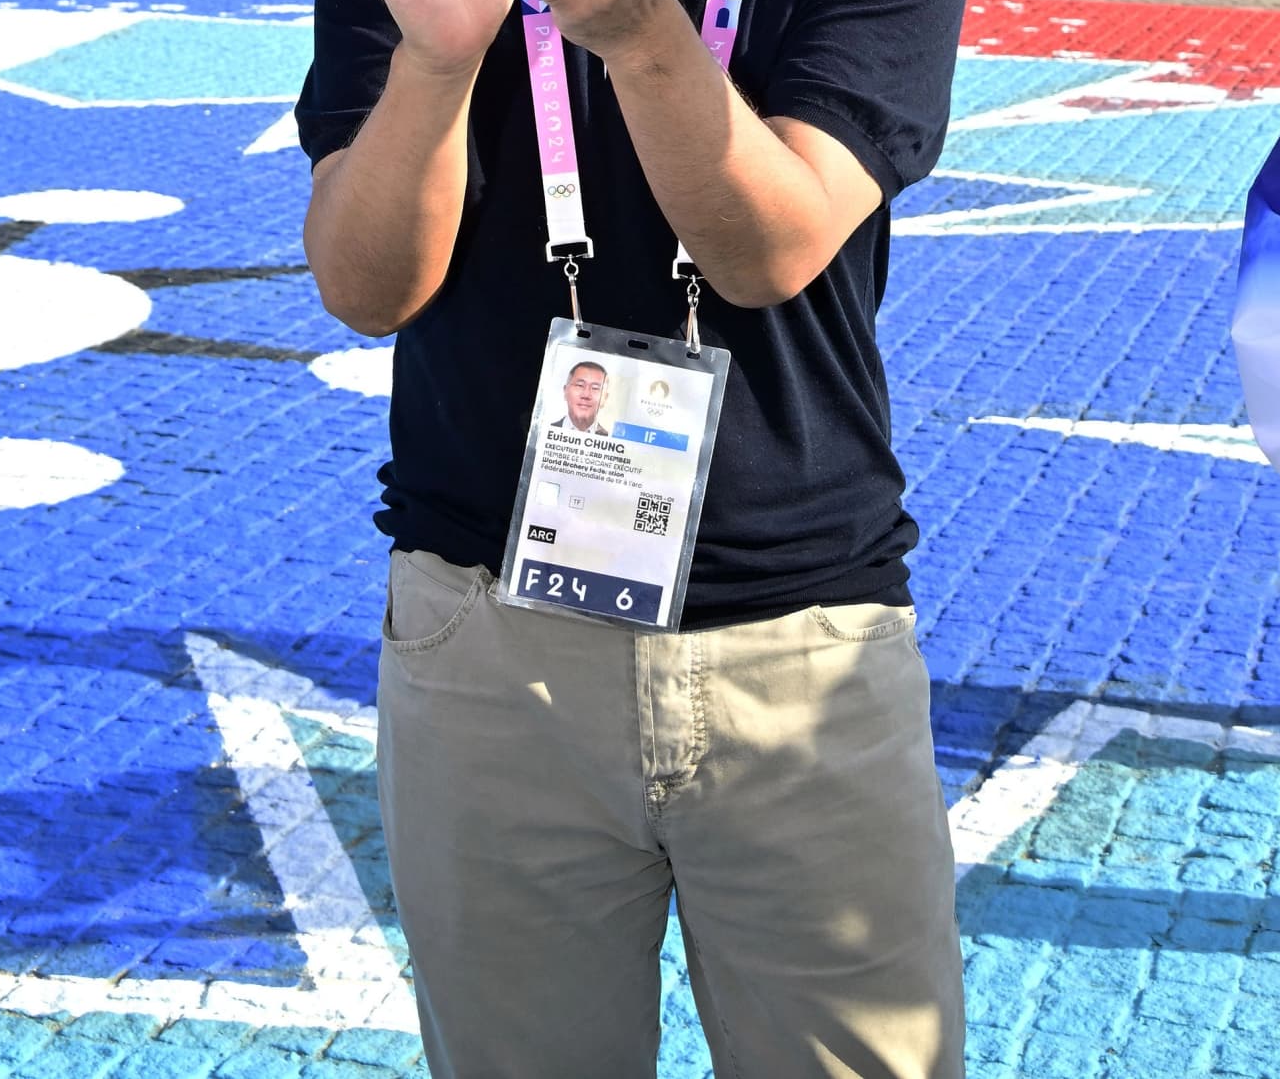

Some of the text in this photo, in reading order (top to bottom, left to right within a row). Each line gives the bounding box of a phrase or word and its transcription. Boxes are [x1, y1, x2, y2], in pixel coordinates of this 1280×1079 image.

[535, 25, 565, 163] PARIS 2024
[547, 430, 625, 454] Euisun CHUNG
[644, 431, 657, 443] IF
[542, 456, 562, 466] World
[529, 528, 555, 541] ARC
[615, 587, 634, 611] 6
